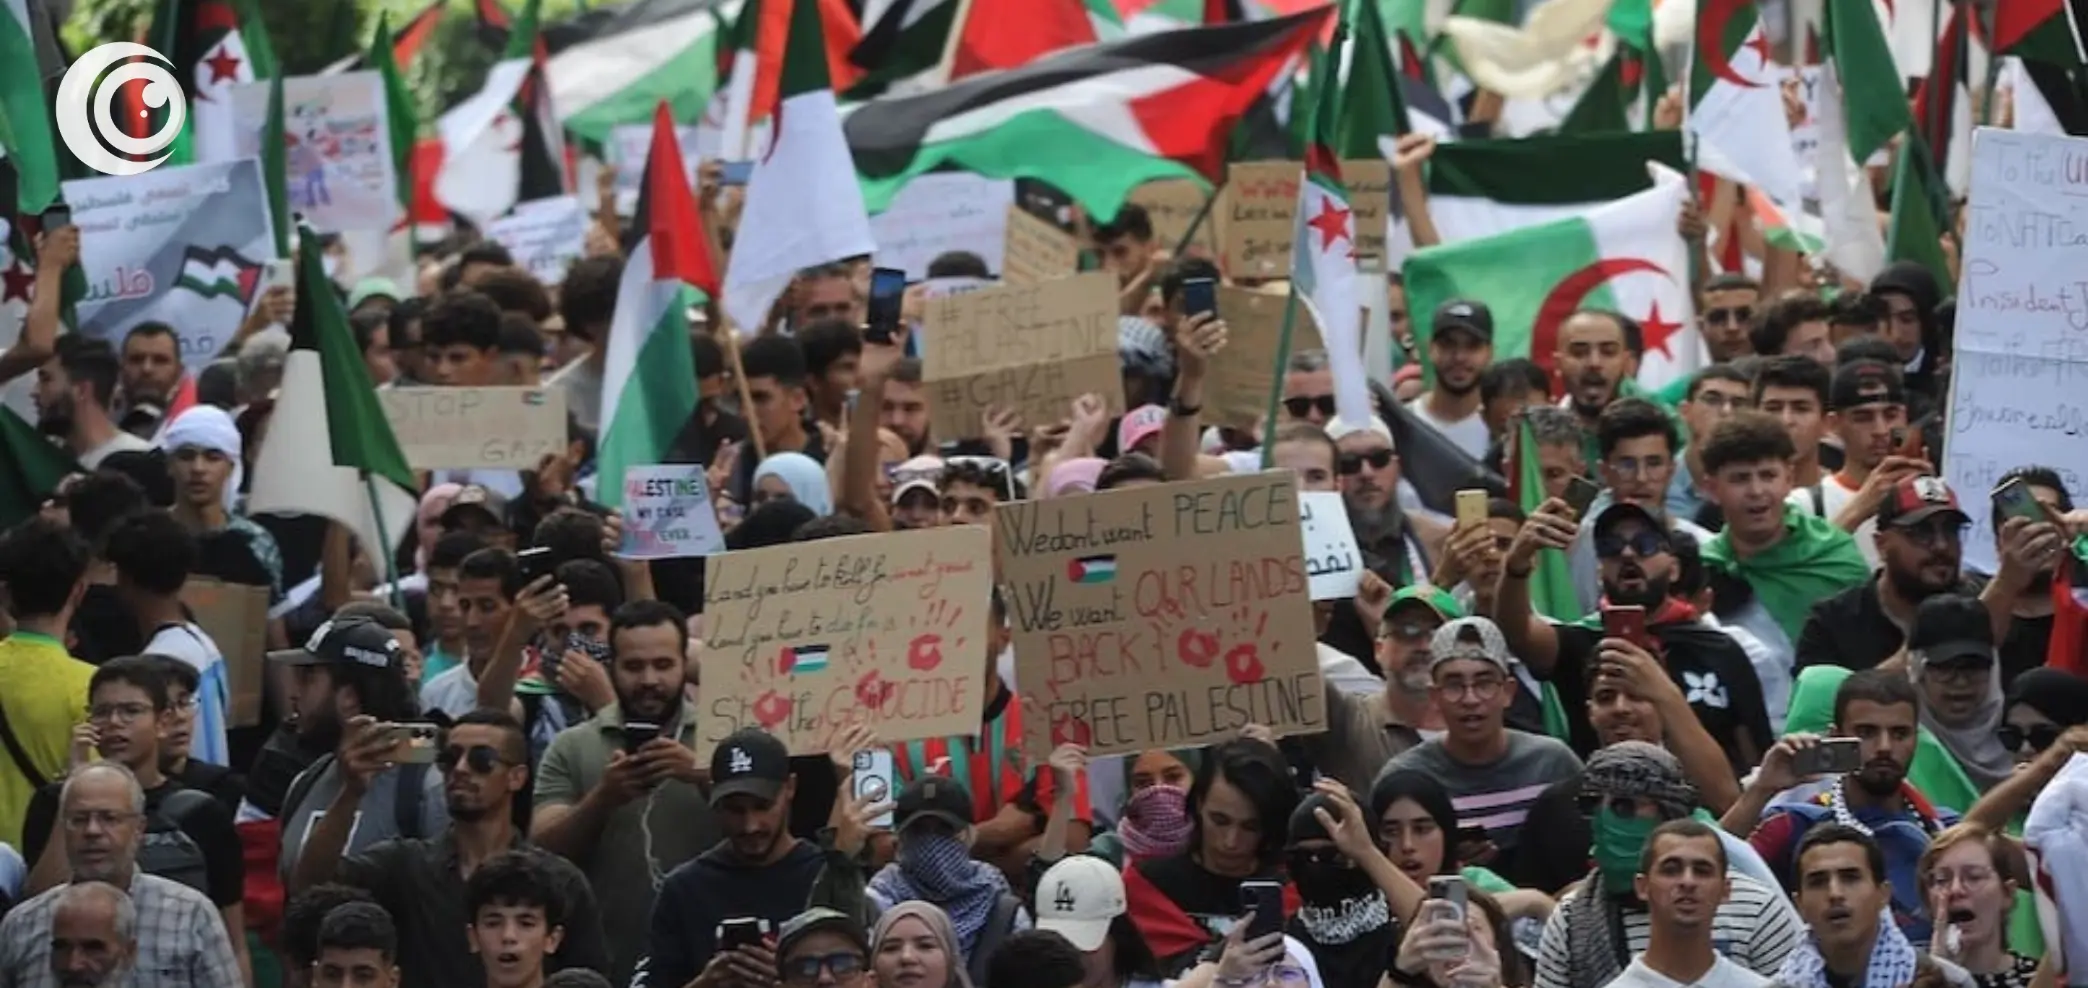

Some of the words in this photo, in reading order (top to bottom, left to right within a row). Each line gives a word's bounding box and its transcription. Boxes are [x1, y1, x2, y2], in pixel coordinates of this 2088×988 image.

[385, 389, 481, 423] STOP
[1001, 502, 1049, 557] We
[1103, 501, 1155, 543] want
[1173, 482, 1291, 536] PEACE
[1008, 573, 1063, 633] We
[1071, 585, 1128, 627] want
[1135, 563, 1206, 618] OUR
[1209, 554, 1306, 609] LANDS
[1046, 630, 1143, 686] BACK
[1048, 695, 1136, 748] FREE
[1145, 672, 1324, 744] PALESTINE
[1054, 880, 1076, 913] LA
